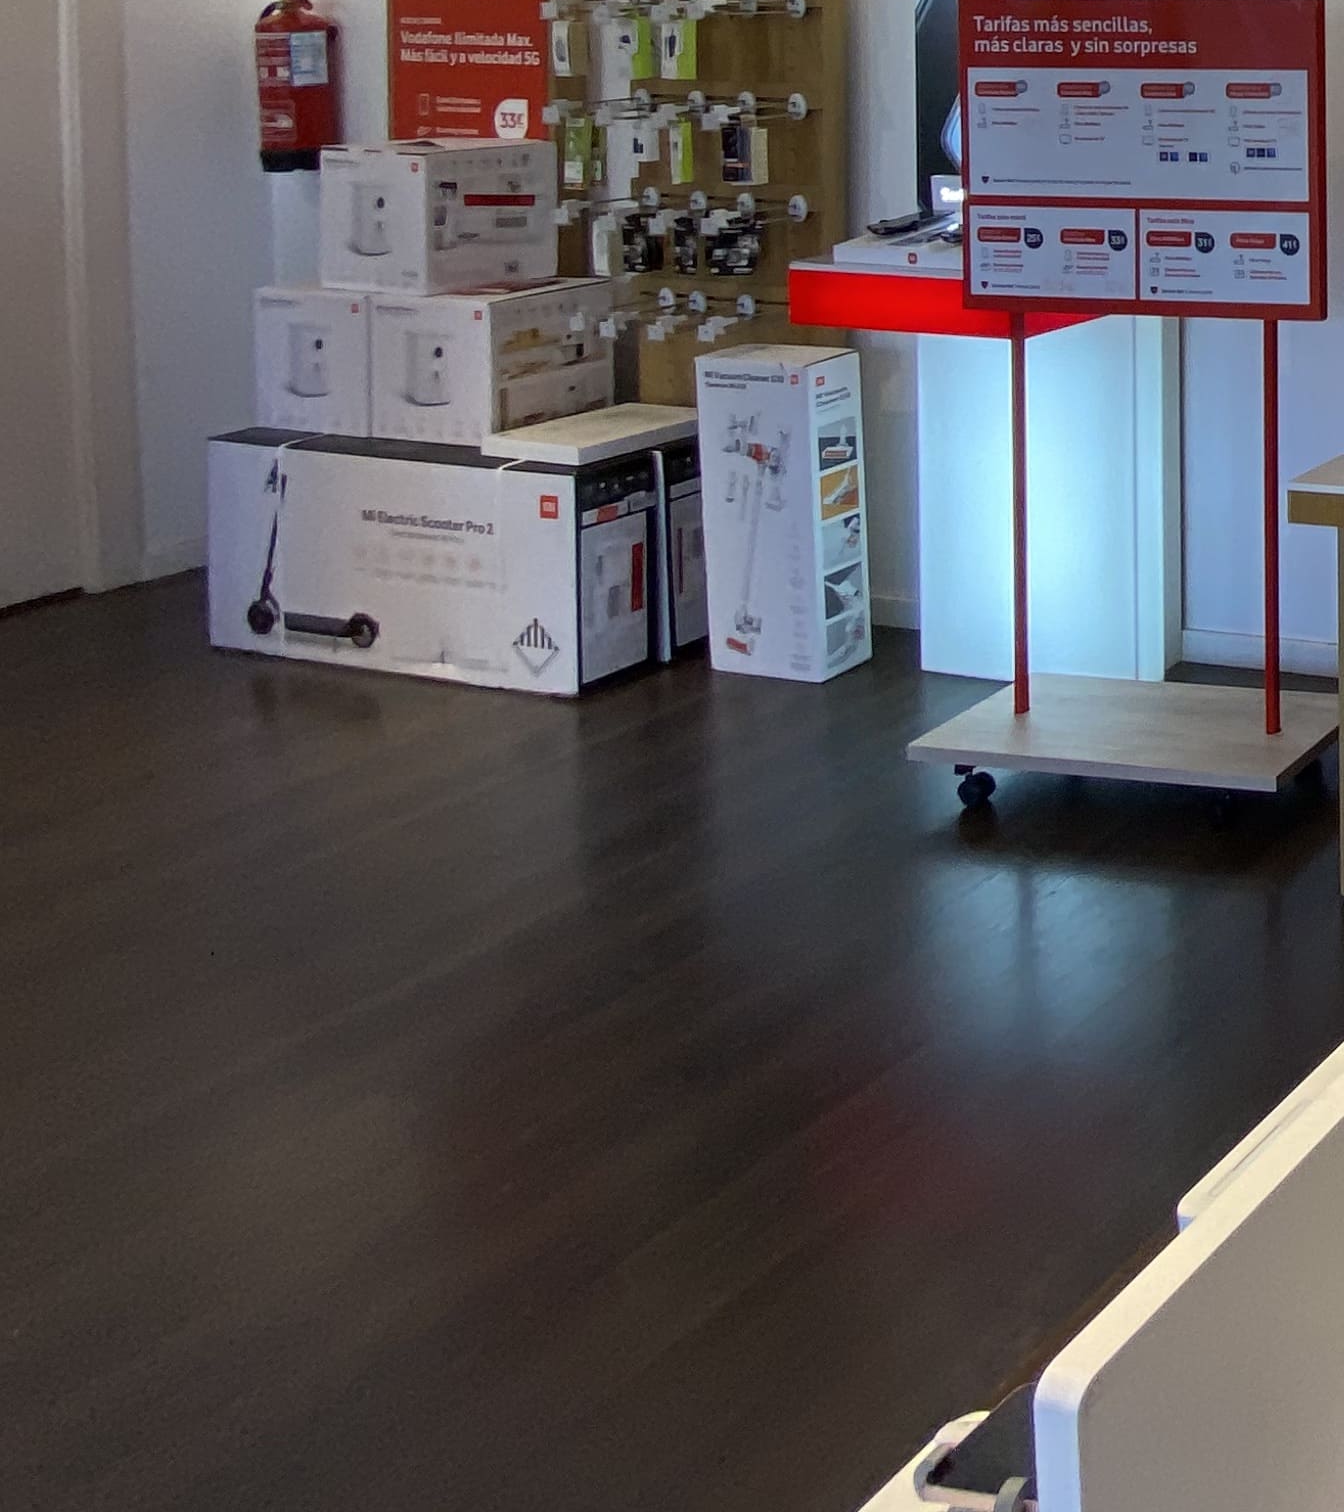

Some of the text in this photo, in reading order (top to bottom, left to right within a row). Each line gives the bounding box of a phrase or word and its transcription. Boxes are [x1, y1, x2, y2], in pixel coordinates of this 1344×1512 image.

[973, 15, 1153, 35] Tarifas más sencillas,
[974, 37, 1197, 57] más claras y sin sorpresas
[524, 51, 541, 65] 5G
[362, 509, 494, 535] Mi Electric Scooter Pro 2
